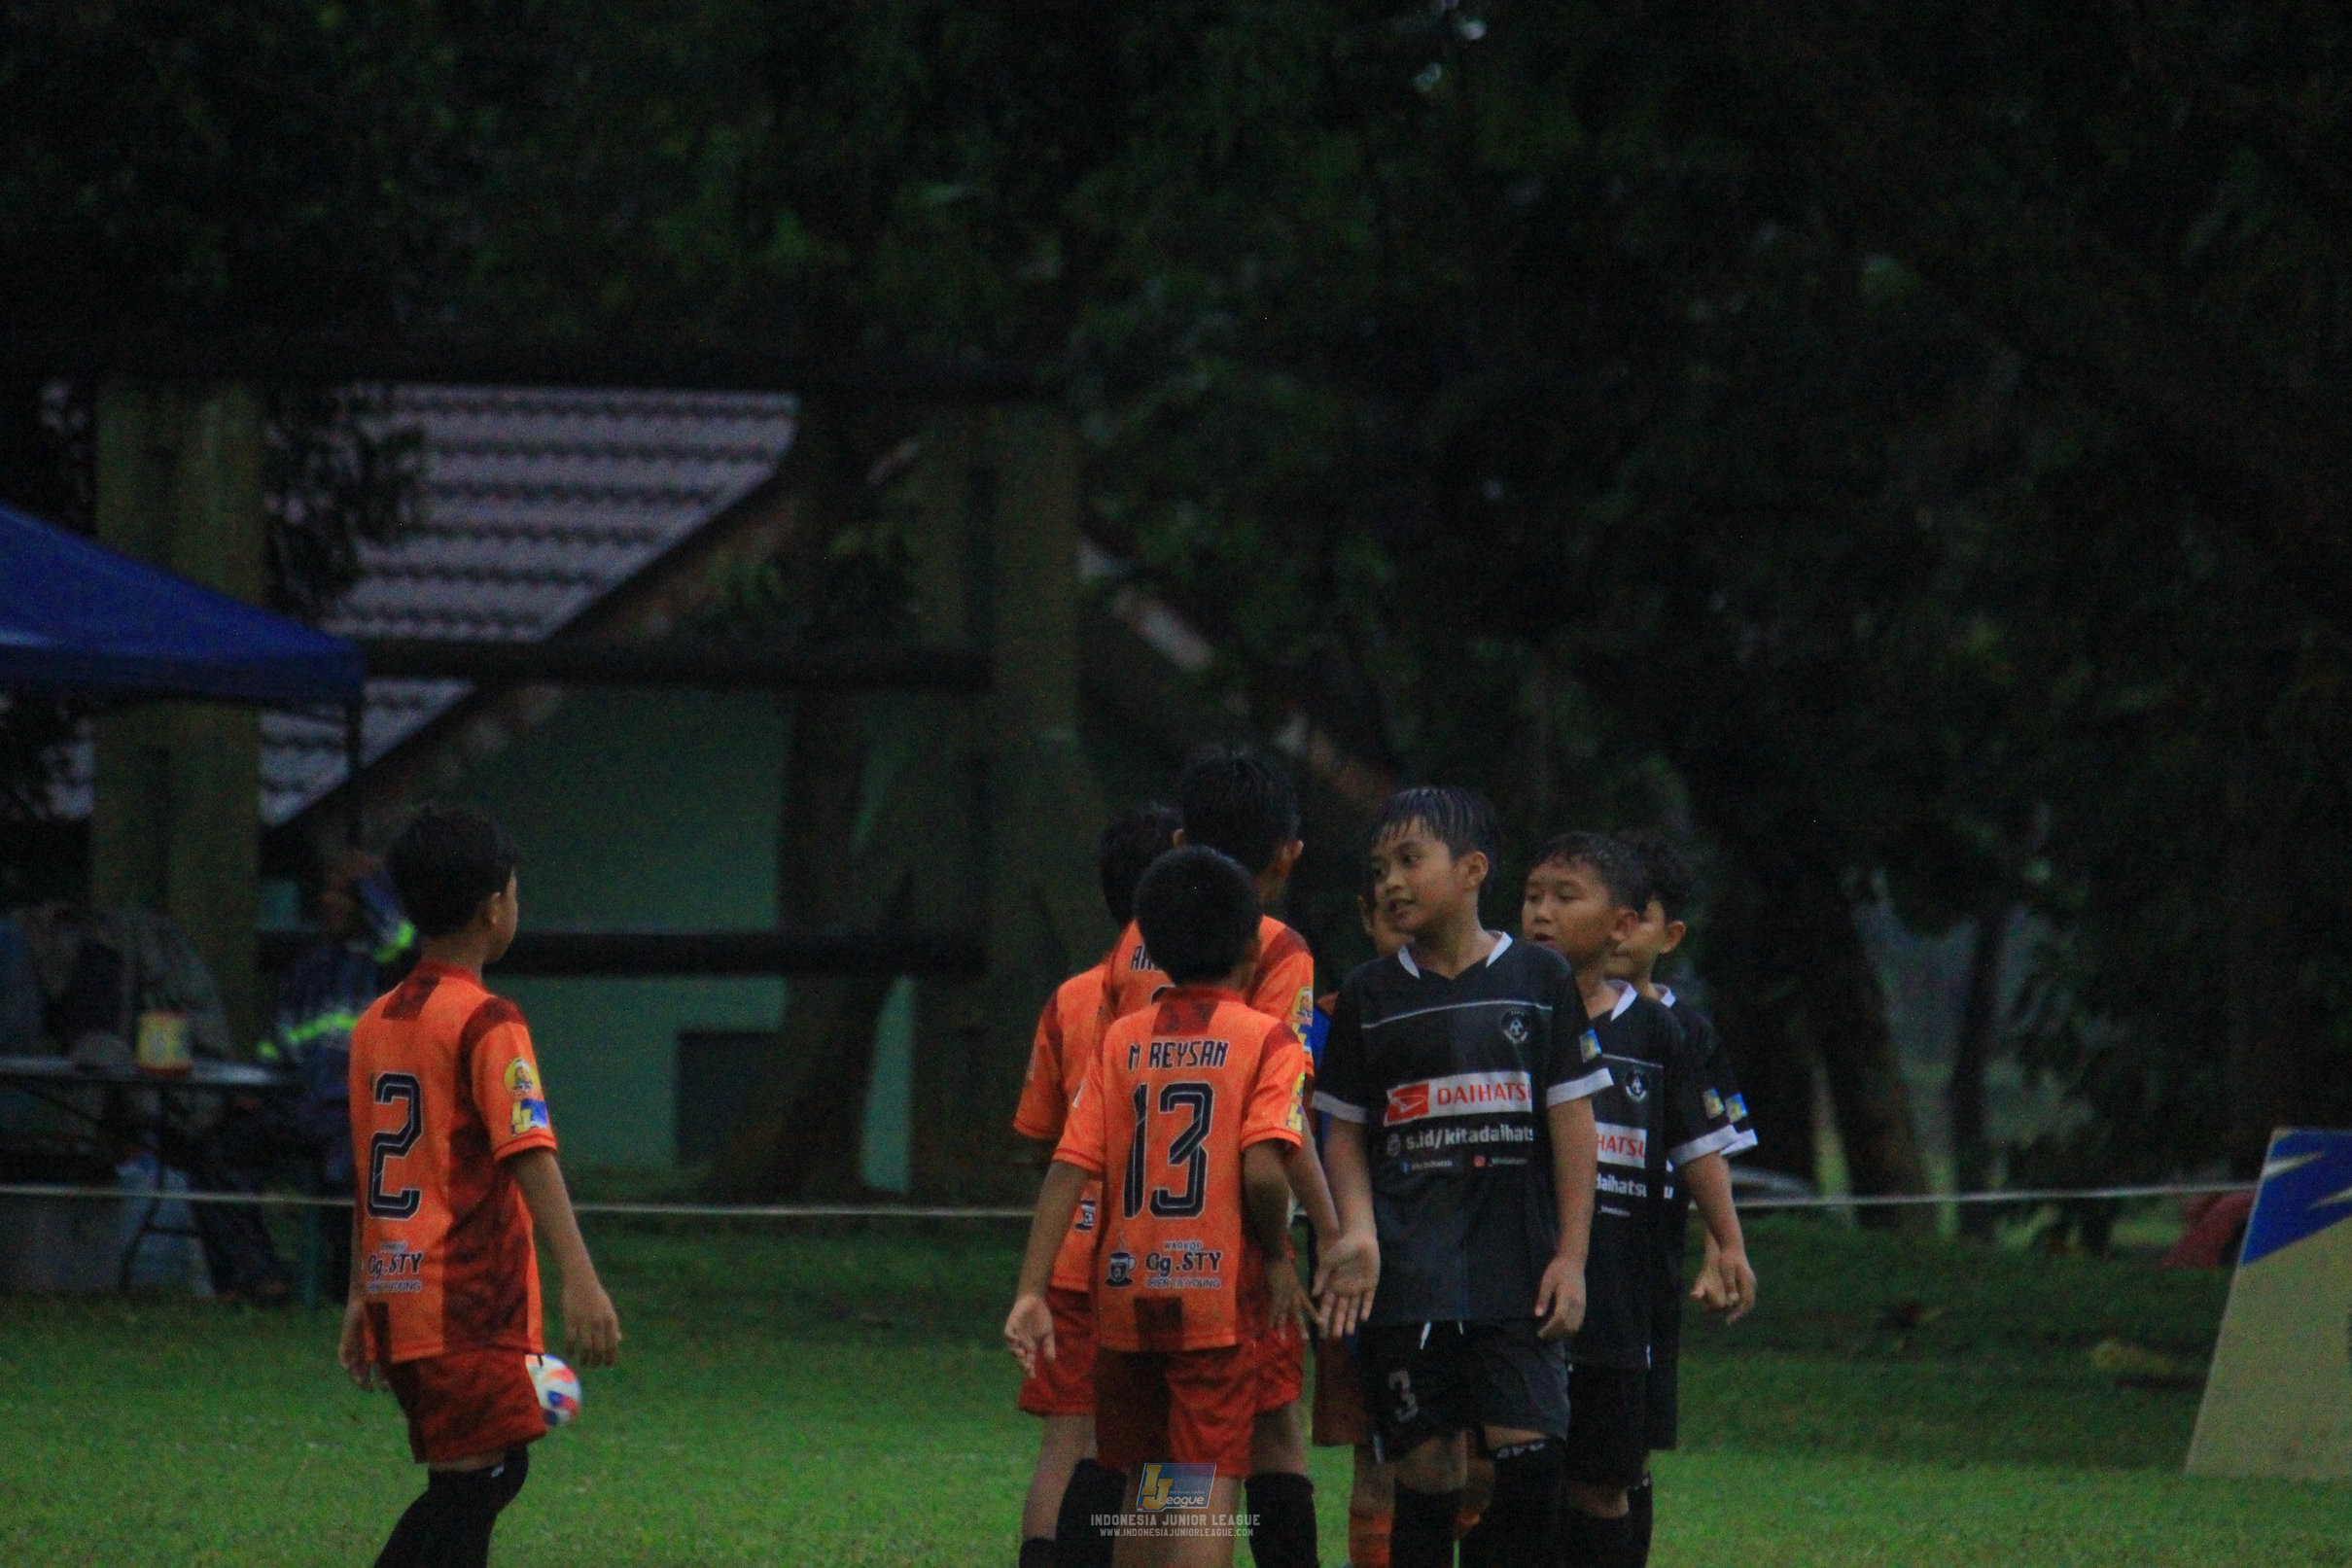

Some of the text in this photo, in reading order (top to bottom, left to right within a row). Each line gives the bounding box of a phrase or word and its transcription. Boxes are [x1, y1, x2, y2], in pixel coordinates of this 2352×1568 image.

[1148, 1039, 1229, 1068] REYSAN
[367, 1072, 423, 1220] 2
[1124, 1082, 1214, 1219] 13
[1388, 1370, 1420, 1423] 3
